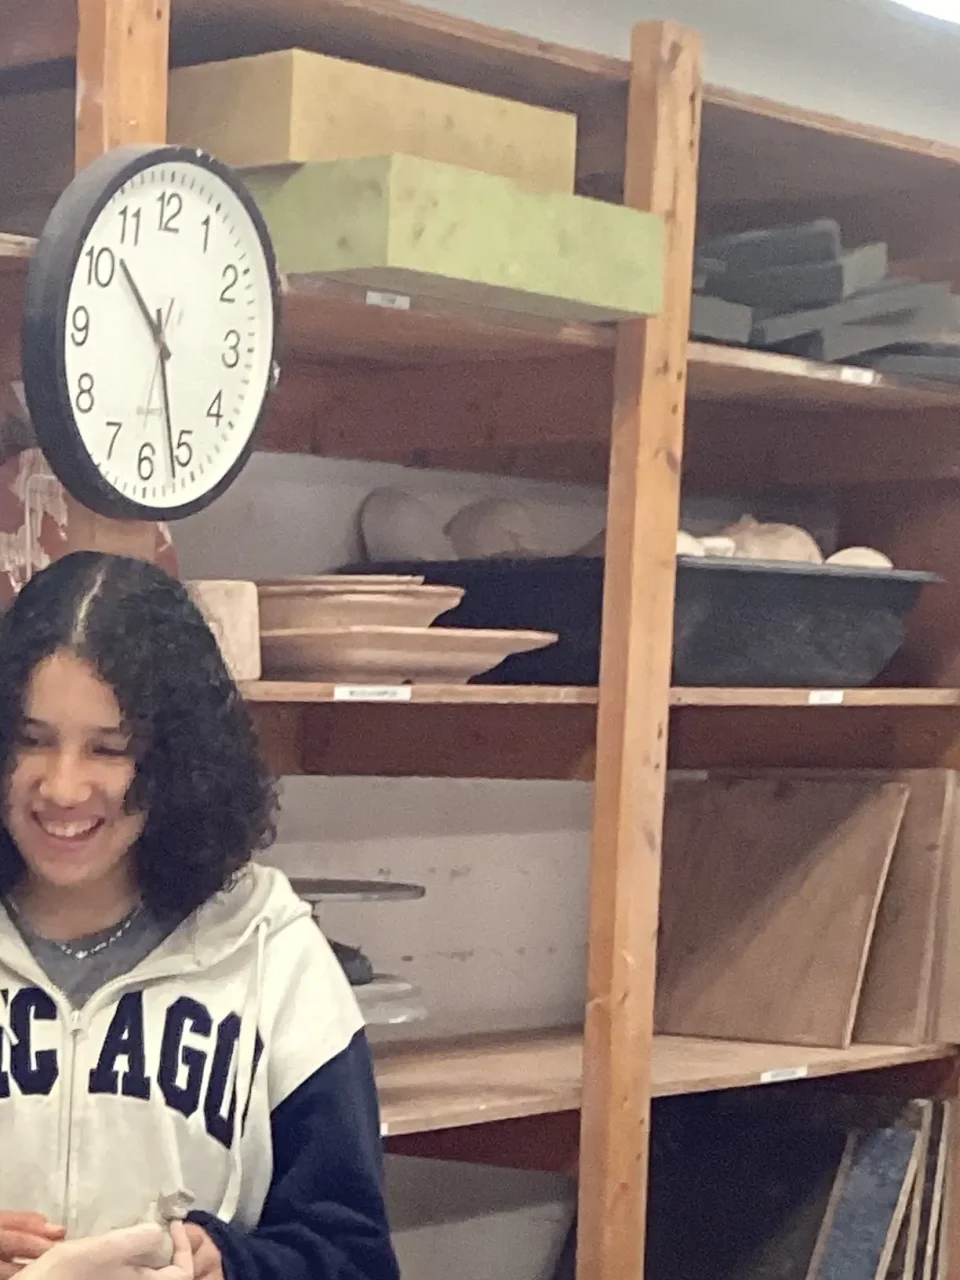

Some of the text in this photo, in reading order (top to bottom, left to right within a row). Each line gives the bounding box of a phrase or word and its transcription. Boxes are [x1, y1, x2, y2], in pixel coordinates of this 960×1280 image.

[118, 206, 142, 246] 11
[157, 192, 183, 233] 12
[200, 215, 211, 253] 1
[85, 245, 115, 288] 10
[219, 264, 239, 303] 2
[71, 305, 90, 346] 9
[221, 329, 240, 368] 3
[75, 373, 95, 413] 8
[206, 389, 224, 427] 4
[105, 421, 122, 460] 7
[174, 429, 193, 467] 5
[137, 442, 154, 481] 6
